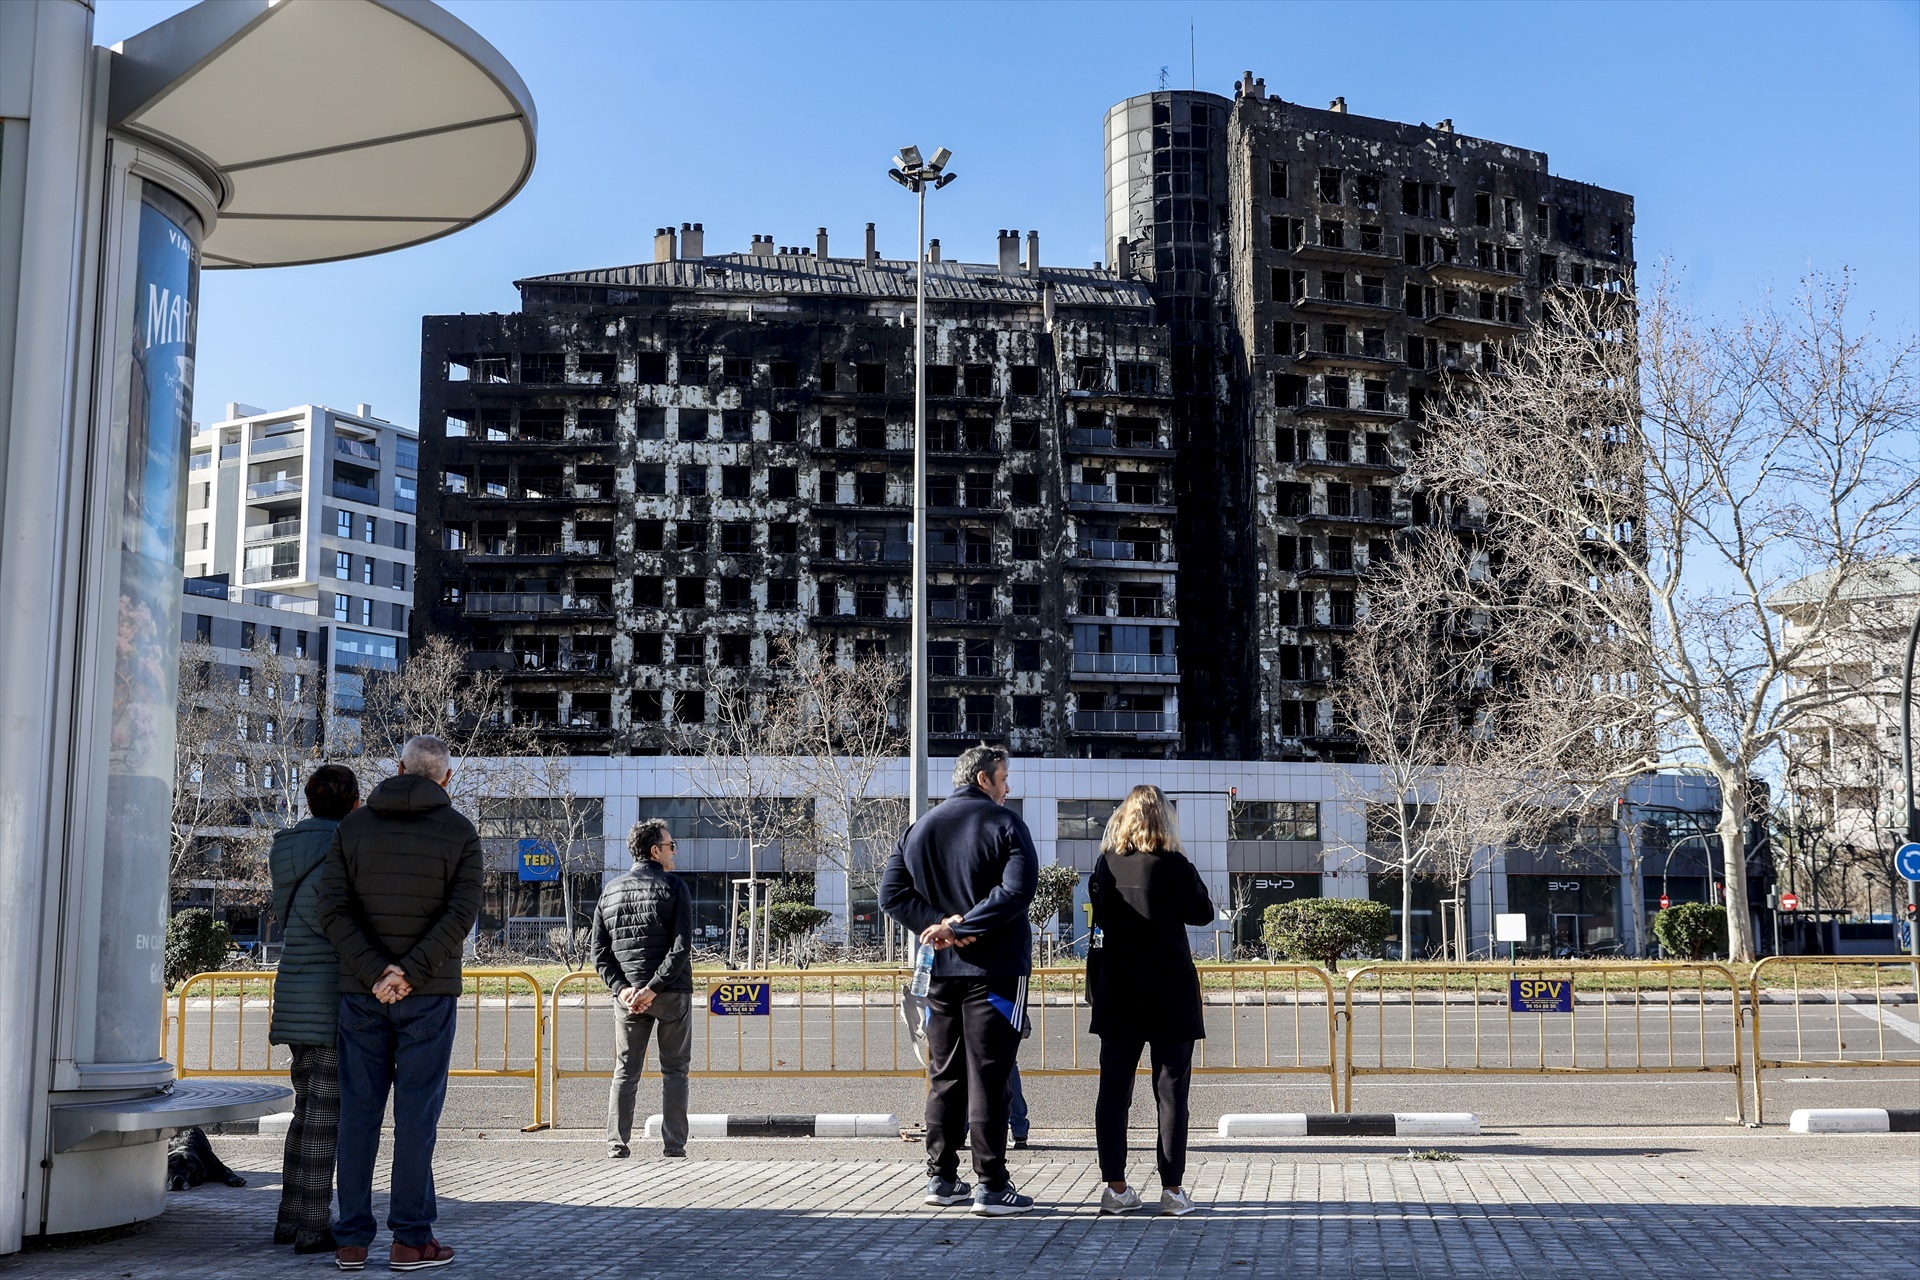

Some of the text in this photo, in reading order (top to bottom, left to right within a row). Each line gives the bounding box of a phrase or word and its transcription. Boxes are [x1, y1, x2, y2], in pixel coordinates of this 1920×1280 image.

[168, 229, 199, 265] VIAJE
[1255, 879, 1295, 889] BYD
[1548, 881, 1580, 890] BYD
[136, 934, 149, 949] EN
[719, 985, 760, 1002] SPV
[1520, 981, 1562, 998] SPV
